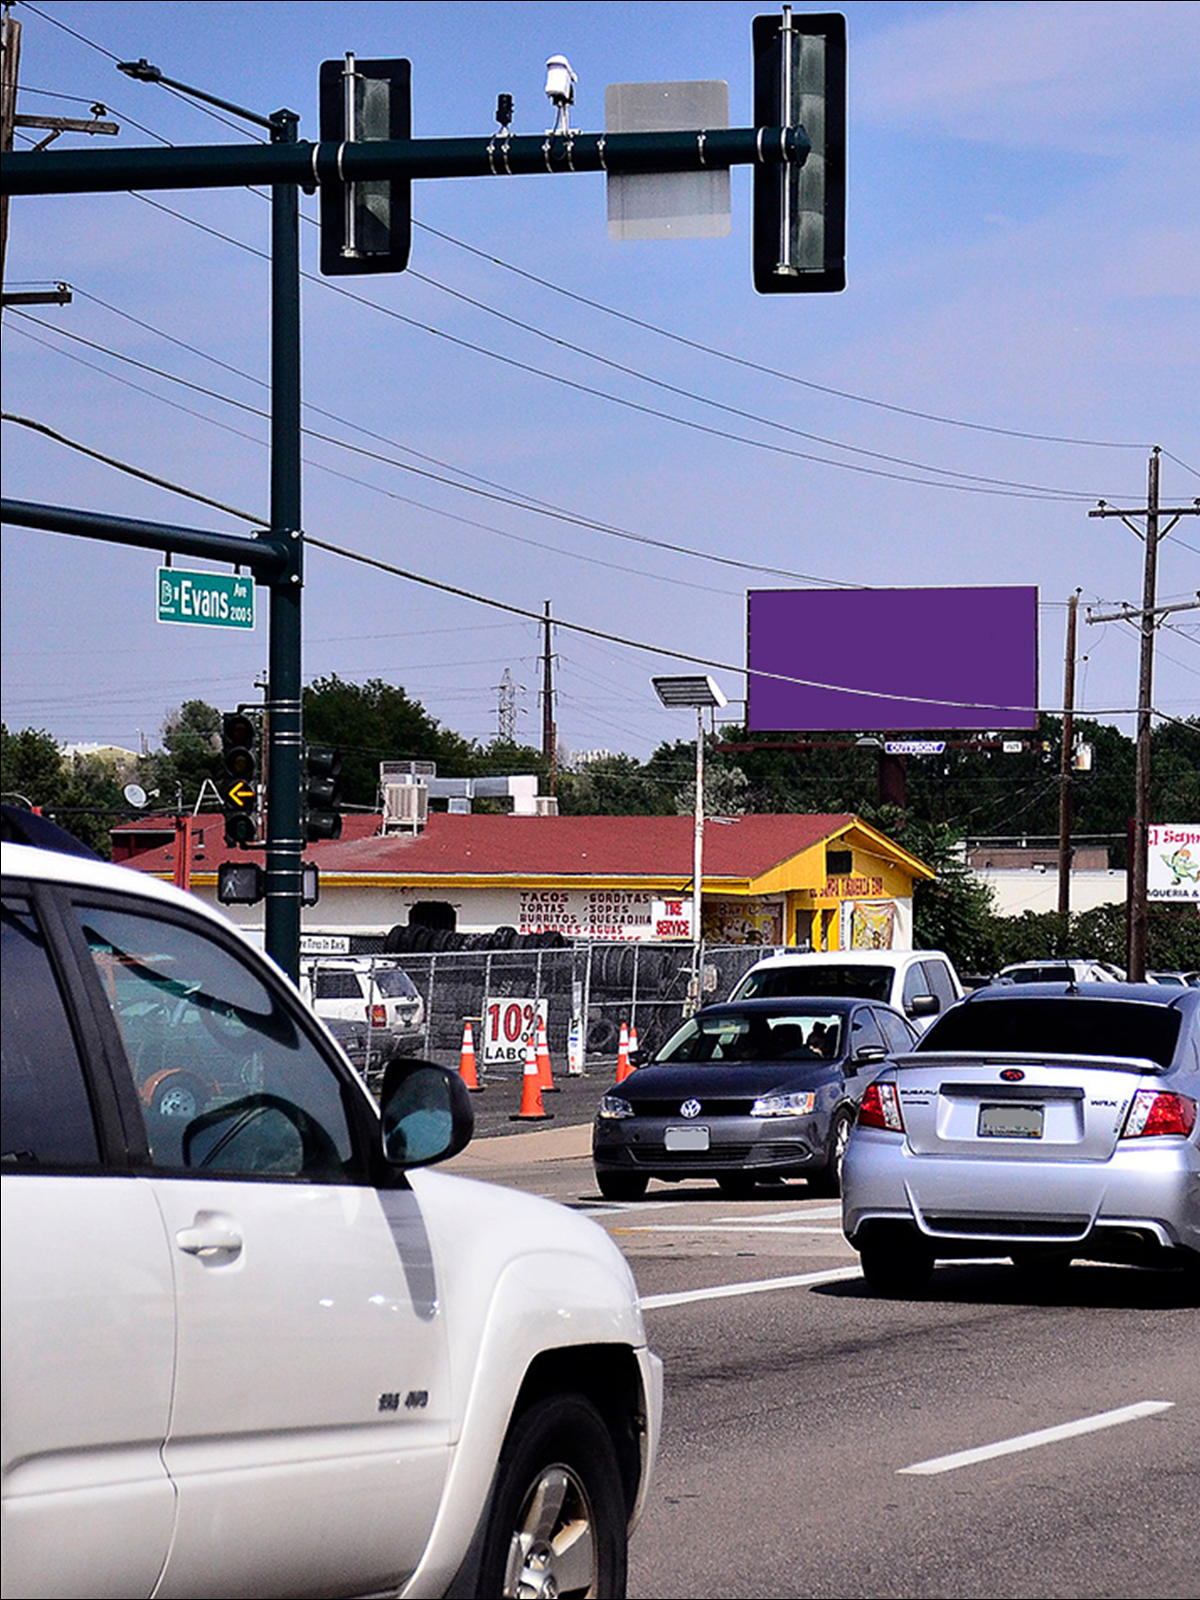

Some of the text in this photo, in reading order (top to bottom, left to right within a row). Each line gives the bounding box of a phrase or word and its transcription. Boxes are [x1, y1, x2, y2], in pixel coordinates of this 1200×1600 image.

[181, 580, 229, 619] Evans
[233, 583, 247, 598] Ave
[519, 892, 650, 904] TACOS GORDITAS
[519, 903, 629, 914] TORTAS SOPES
[665, 901, 683, 916] TIRE
[519, 913, 577, 924] BURRITOS
[589, 925, 623, 934] AGUAS
[655, 920, 690, 936] SERVICE
[488, 1003, 544, 1043] 10%
[485, 1047, 527, 1060] LABO
